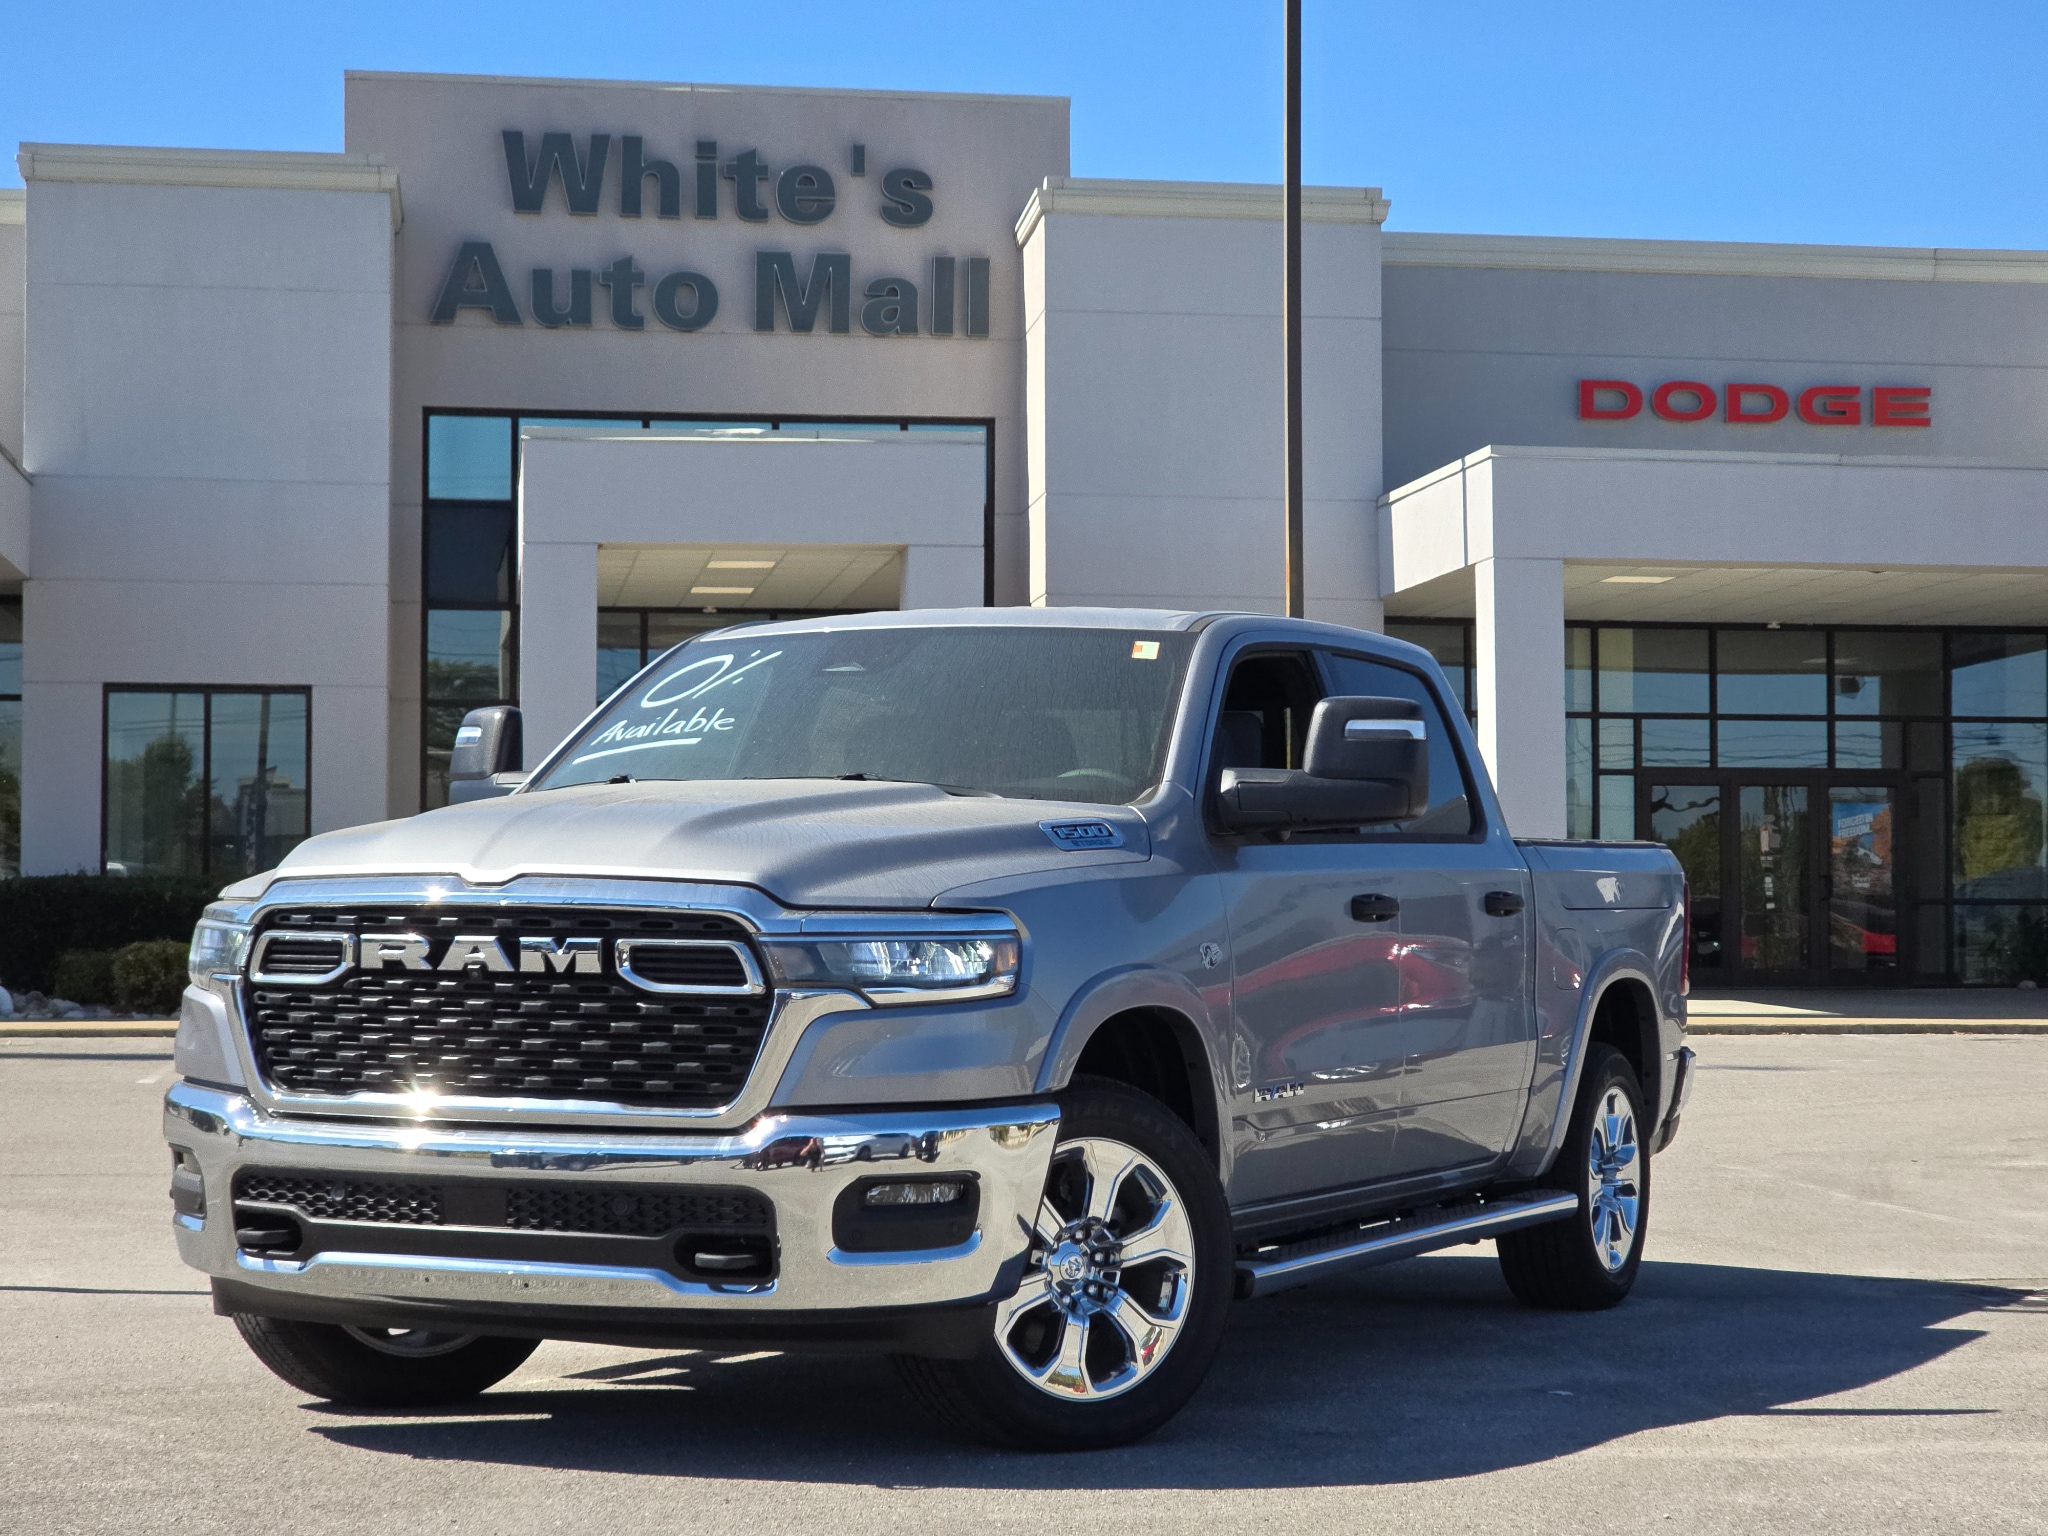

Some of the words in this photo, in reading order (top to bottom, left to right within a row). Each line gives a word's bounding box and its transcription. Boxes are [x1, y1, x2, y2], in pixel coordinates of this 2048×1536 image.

[502, 130, 934, 227] White's
[430, 242, 719, 331] Auto
[754, 251, 991, 337] Mall
[1578, 379, 1932, 427] DODGE
[640, 649, 784, 708] 0%
[590, 706, 736, 746] Available
[1052, 825, 1109, 839] 1500
[359, 933, 603, 974] RAM
